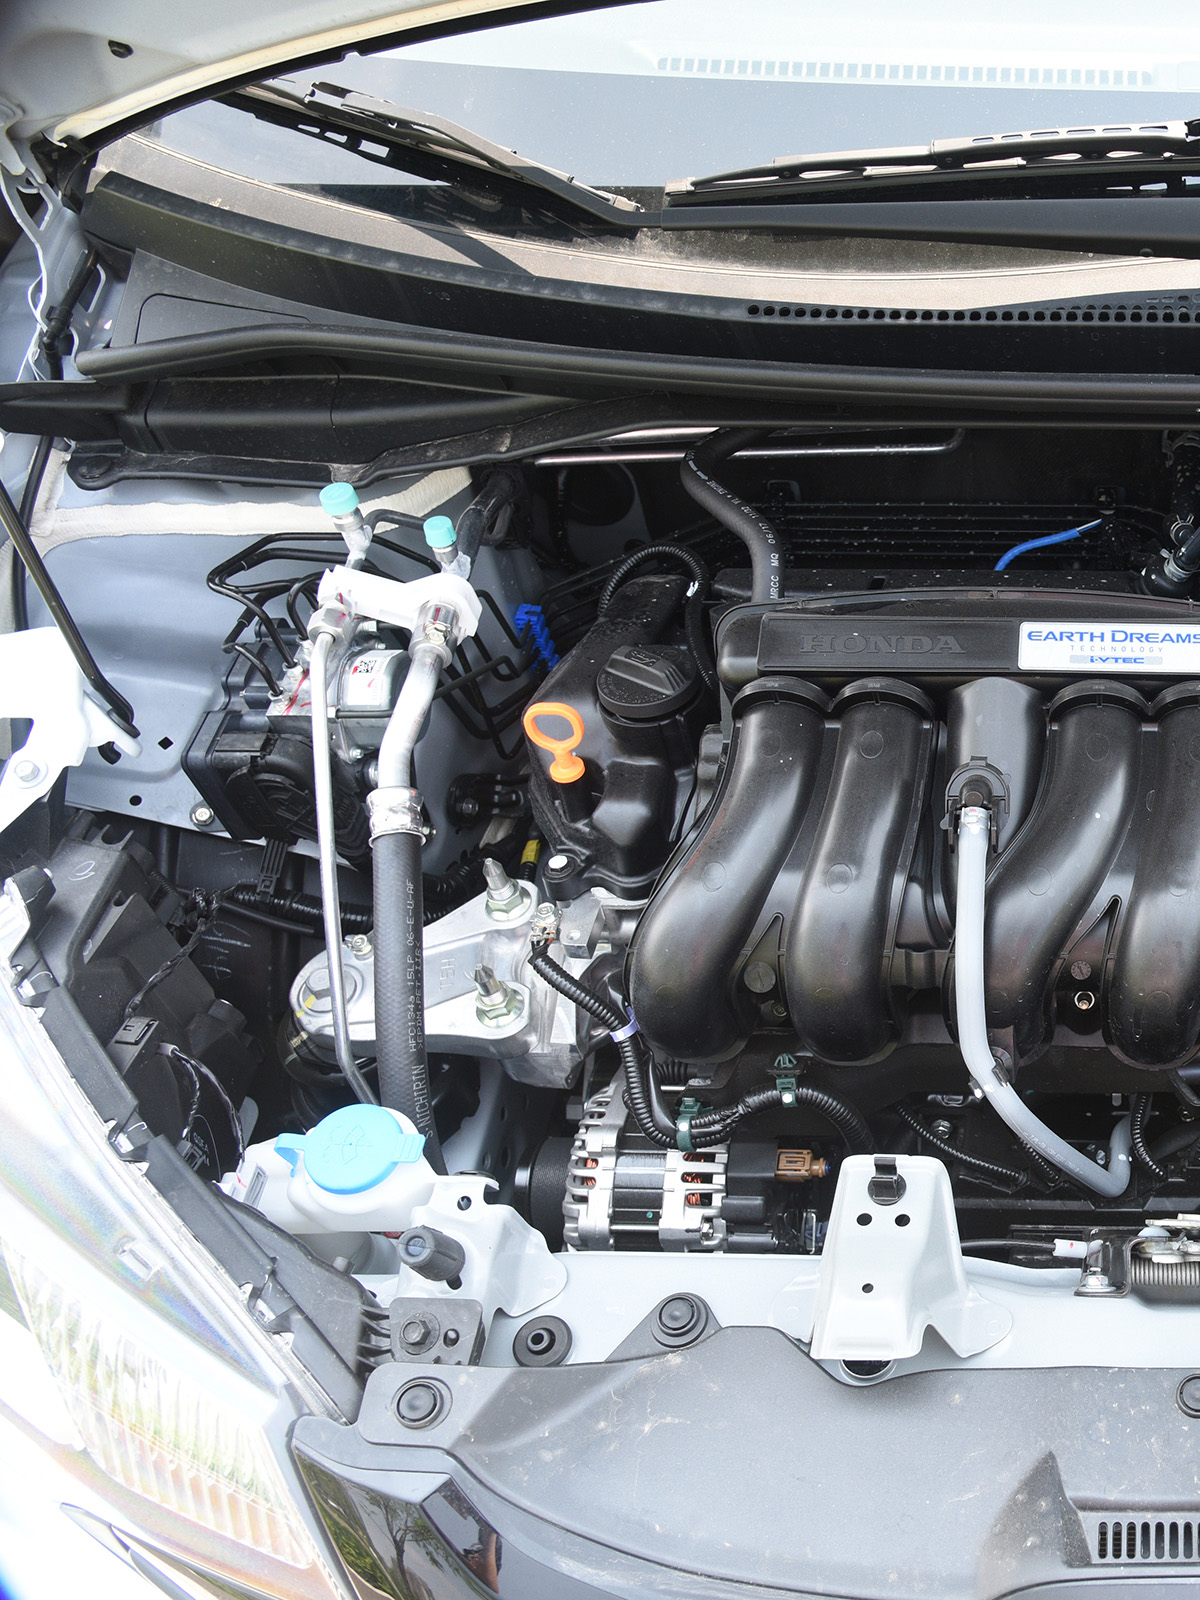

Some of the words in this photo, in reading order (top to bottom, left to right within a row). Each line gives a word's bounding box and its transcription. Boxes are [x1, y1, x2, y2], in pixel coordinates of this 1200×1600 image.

[758, 523, 775, 544] 06/17
[770, 552, 779, 567] MQ
[770, 575, 779, 600] MRCC
[800, 634, 967, 655] HONDA
[1027, 630, 1105, 642] EARTH
[1070, 645, 1164, 653] TECHNOLOGY
